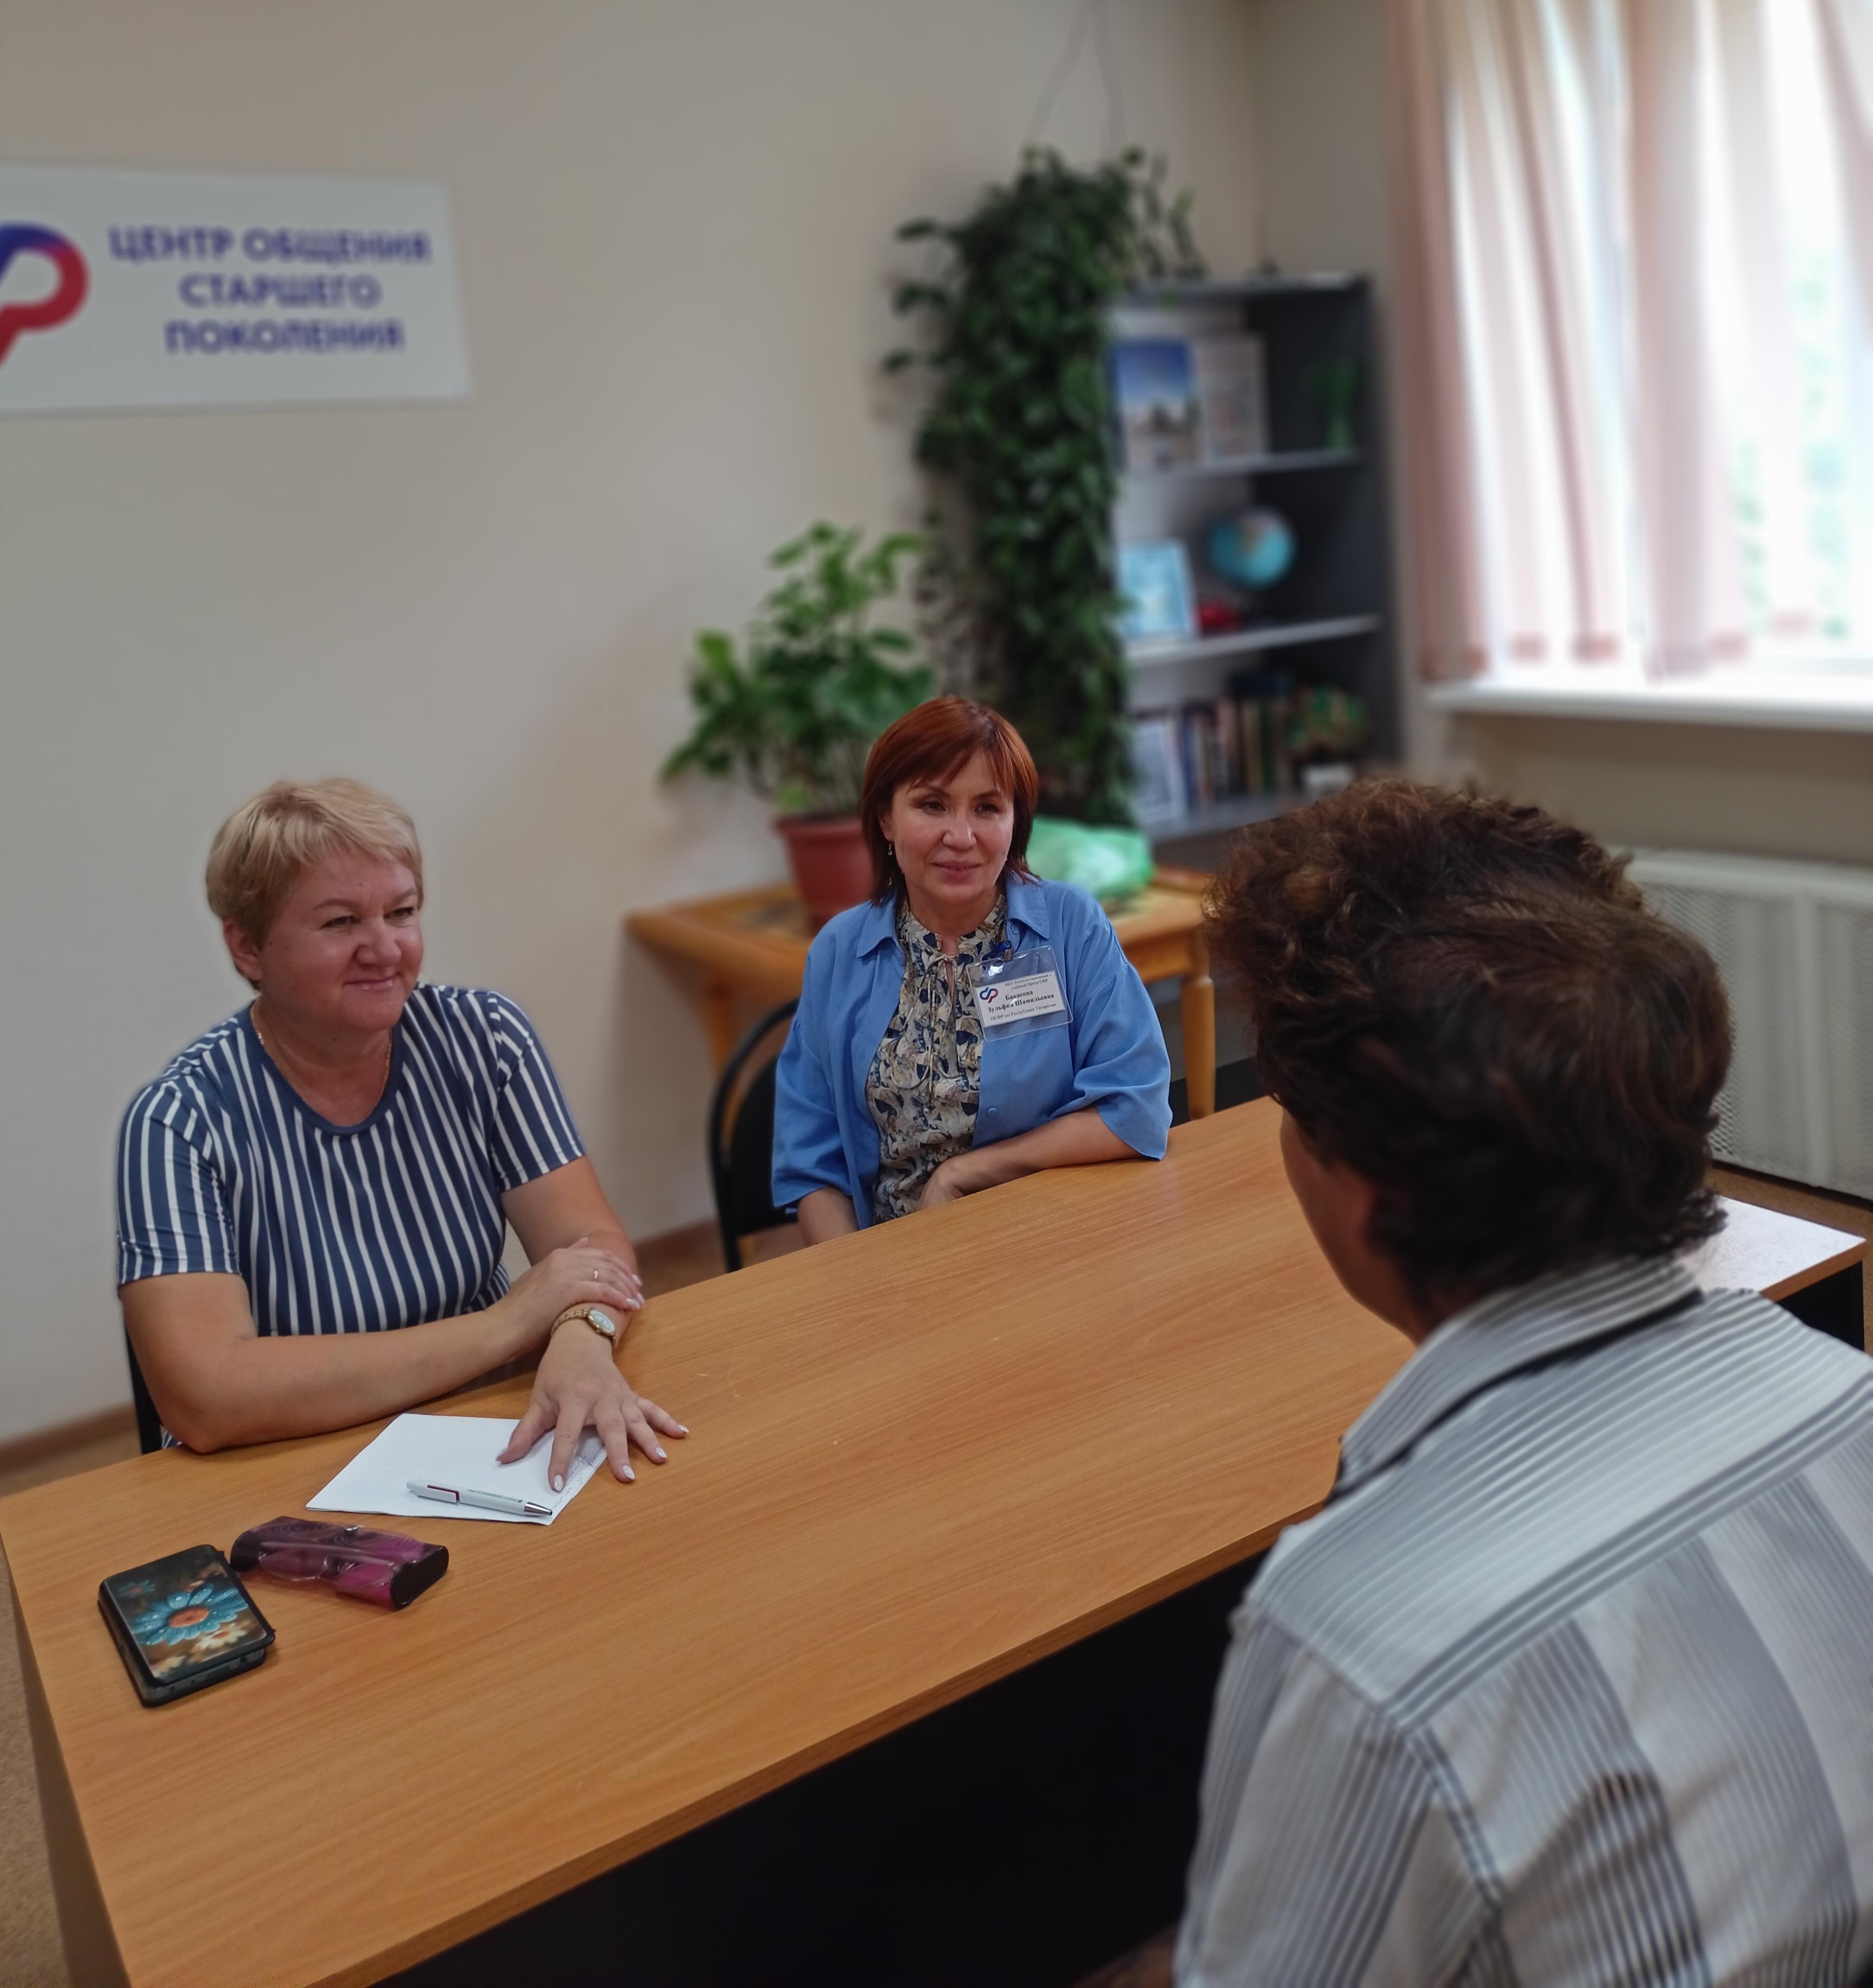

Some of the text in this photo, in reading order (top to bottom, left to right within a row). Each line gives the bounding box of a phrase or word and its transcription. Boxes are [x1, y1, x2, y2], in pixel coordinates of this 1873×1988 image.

[109, 225, 432, 265] ЦЕНТР ОБЩЕНИЯ
[178, 274, 383, 309] СТАРШЕГО
[165, 319, 405, 354] ПОКОЛЕНИЯ
[988, 994, 1055, 1013] Зульфия Шамильевна
[1005, 990, 1033, 1001] Бакасова
